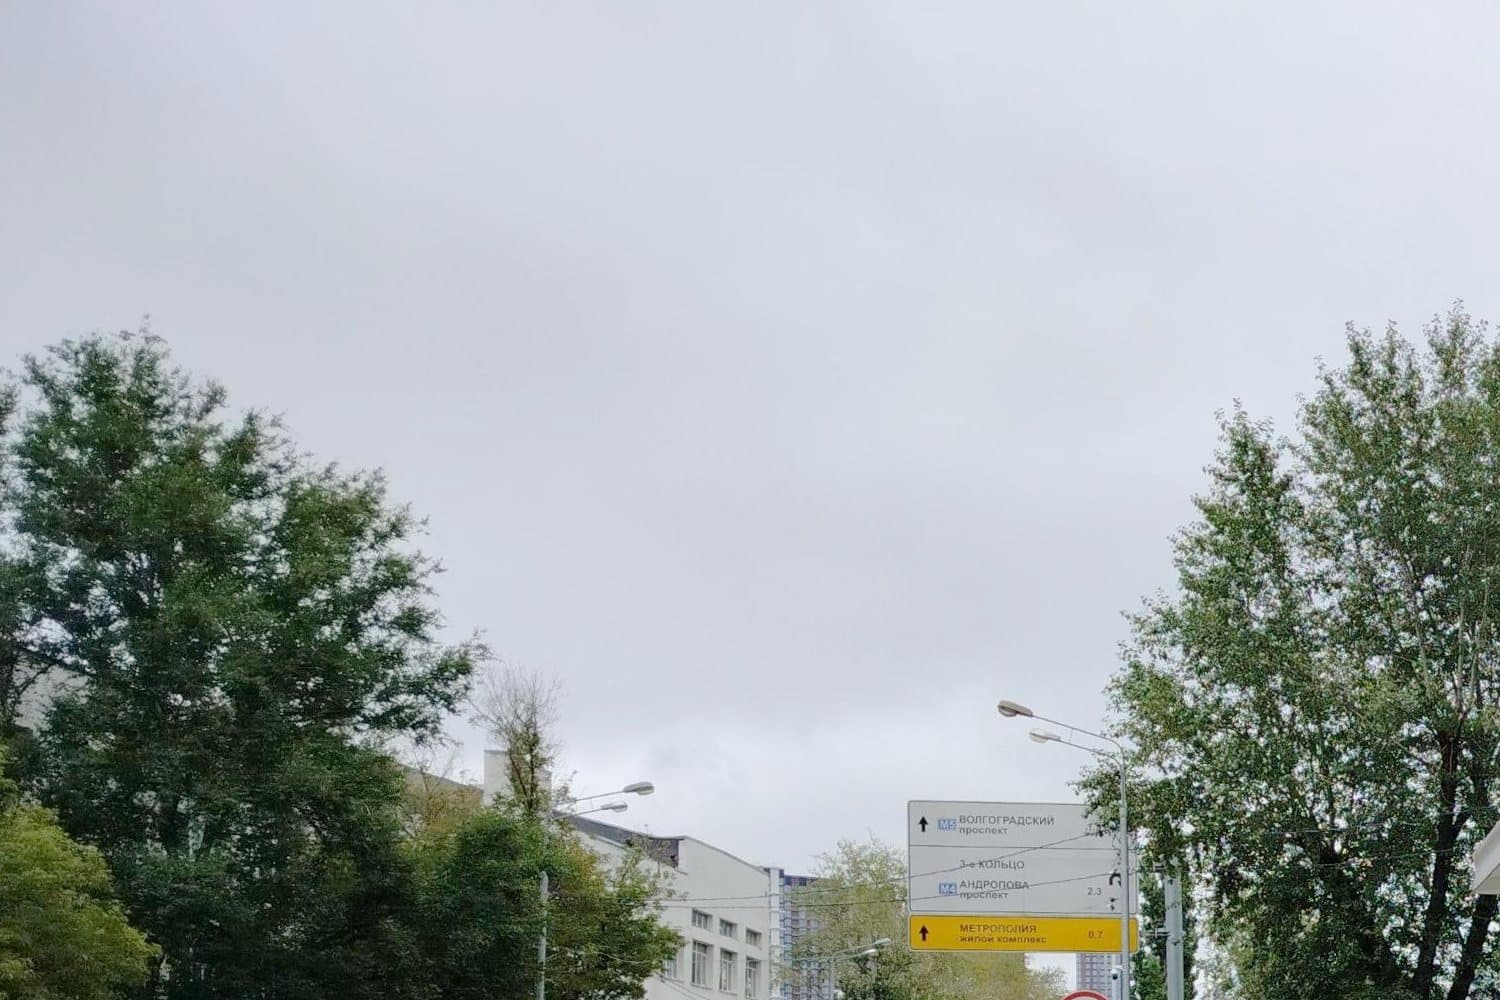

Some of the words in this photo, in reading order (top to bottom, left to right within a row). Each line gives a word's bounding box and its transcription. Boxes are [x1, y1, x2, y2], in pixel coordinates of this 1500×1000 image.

[959, 814, 1055, 826] ВОЛГОГРАДСКИЙ
[959, 827, 1008, 835] проспект
[978, 859, 1025, 871] КОЛЬЦО
[959, 880, 1029, 890] АНДРОПОВА
[959, 891, 1009, 900] проспект
[959, 924, 1037, 934] МЕТРОПОЛИЯ
[959, 934, 994, 943] жилой
[997, 936, 1047, 944] комплекс
